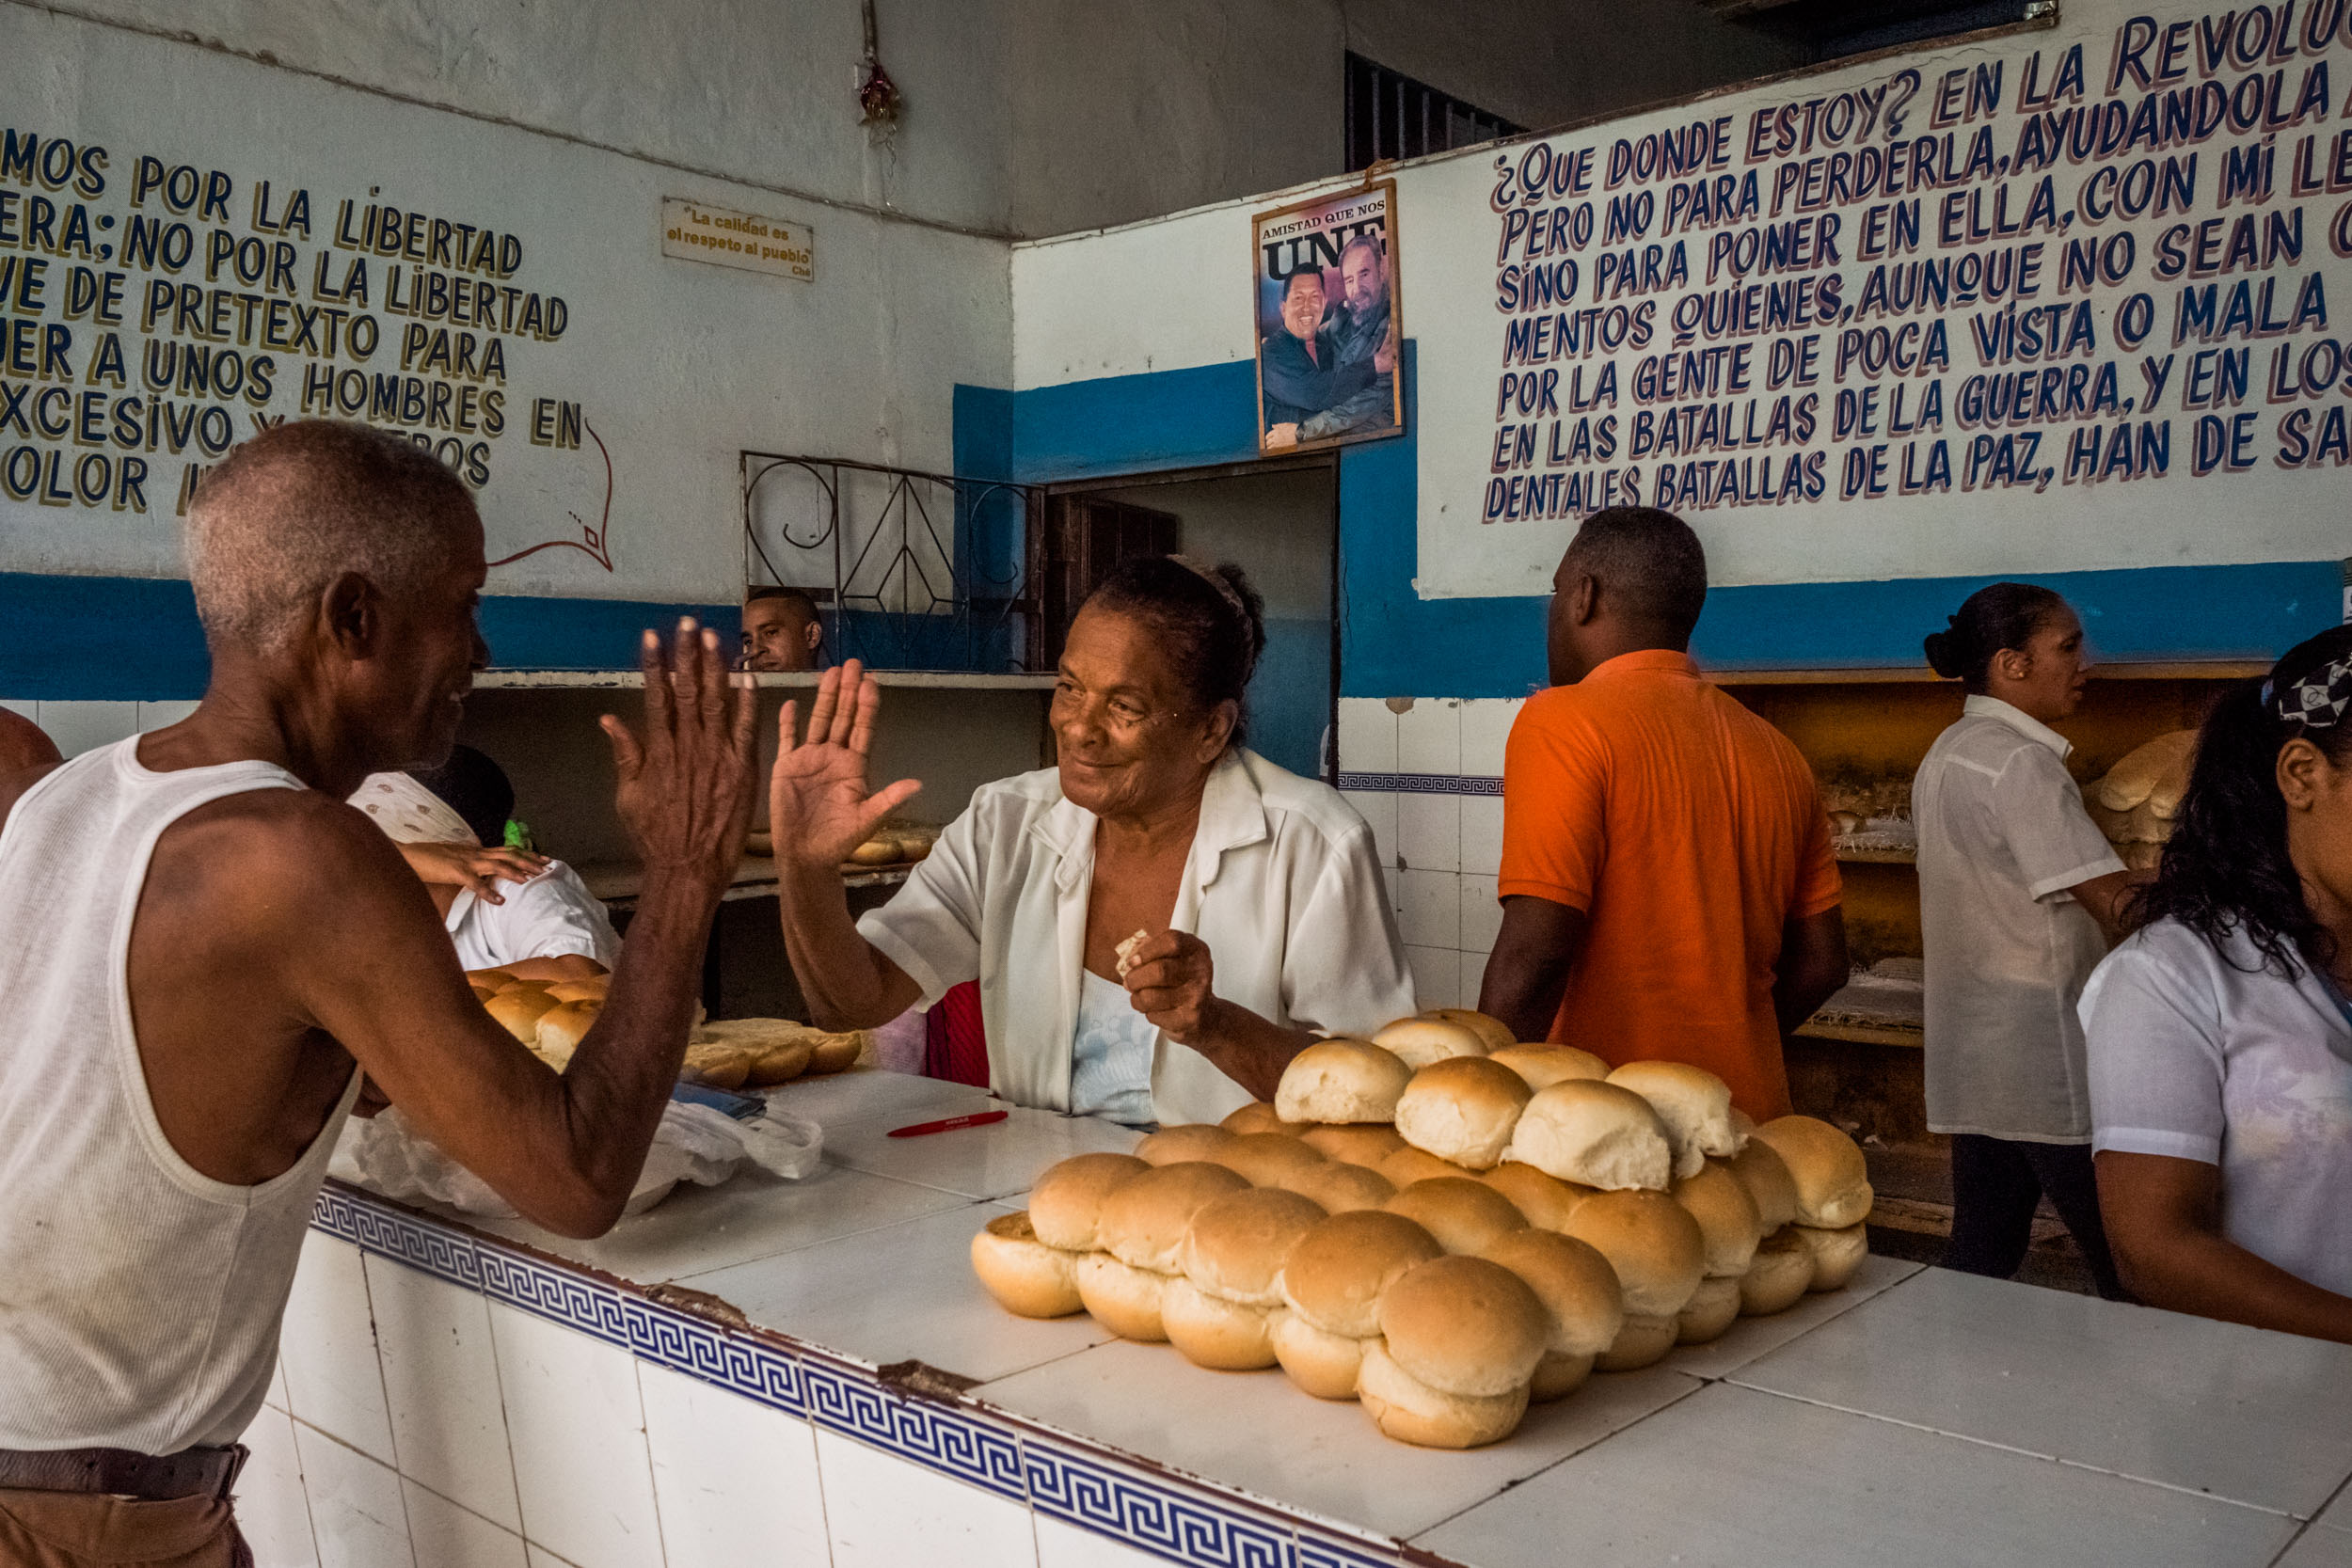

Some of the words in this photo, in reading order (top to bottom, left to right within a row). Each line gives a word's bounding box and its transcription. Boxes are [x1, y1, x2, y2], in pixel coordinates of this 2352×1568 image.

[1604, 115, 1733, 192] DONDE
[1743, 68, 1921, 166] ESTOY?
[1930, 59, 2003, 130] EN
[2016, 43, 2085, 114] LA
[2105, 0, 2352, 96] REVOLU
[0, 128, 109, 200] MOS
[131, 155, 232, 223] POR
[251, 181, 310, 241] LA
[1263, 217, 1321, 240] AMISTAD
[1325, 208, 1354, 224] QUE
[1358, 200, 1385, 215] NOS
[1497, 201, 1594, 267] PERO
[1601, 190, 1654, 247] NO
[1661, 168, 1759, 238] PARA
[1769, 124, 2010, 218] PERDERLA,
[2010, 60, 2329, 174] AYUDANDOLA
[119, 214, 194, 275] NO
[205, 229, 296, 297] POR
[312, 250, 369, 309] LA
[667, 228, 681, 242] el
[684, 232, 741, 252] respeto
[745, 243, 758, 255] al
[715, 216, 769, 236] calidad
[772, 229, 789, 241] es
[1593, 240, 1689, 303] PARA
[1706, 213, 1842, 286] PONER
[1856, 198, 1920, 261] EN
[1938, 174, 2075, 248] ELLA,
[2077, 151, 2198, 227] CON
[62, 266, 126, 326] DE
[141, 278, 379, 363] PRETEXTO
[401, 323, 505, 385] PARA
[1502, 300, 1656, 368] MENTOS
[1853, 242, 2045, 322] AUNQUE
[2058, 231, 2136, 295] NO
[2151, 206, 2303, 281] SEAN
[86, 333, 126, 388] A
[141, 339, 277, 406] UNOS
[300, 362, 505, 438] HOMBRES
[530, 398, 581, 450] EN
[1496, 368, 1558, 422] POR
[1569, 360, 1618, 414] LA
[1631, 342, 1753, 405] GENTE
[1766, 334, 1820, 390] DE
[1834, 318, 1949, 384] POCA
[2113, 293, 2154, 352] O
[2171, 271, 2328, 349] MALA
[1482, 466, 1642, 525] DENTALES
[1652, 450, 1826, 514] BATALLAS
[1839, 444, 1888, 501] DE
[1898, 439, 1952, 496] LA
[1961, 431, 2055, 494] PAZ,
[2062, 420, 2170, 485] HAN
[2190, 412, 2258, 477] DE
[1490, 422, 1537, 474] EN
[1546, 415, 1618, 467] LAS
[1628, 392, 1820, 461] BATALLAS
[1832, 385, 1880, 443] DE
[1886, 379, 1943, 437] LA
[1954, 360, 2135, 432] GUERRA,
[2140, 354, 2175, 414] Y
[2181, 346, 2250, 411] EN
[1, 446, 149, 514] OLOR
